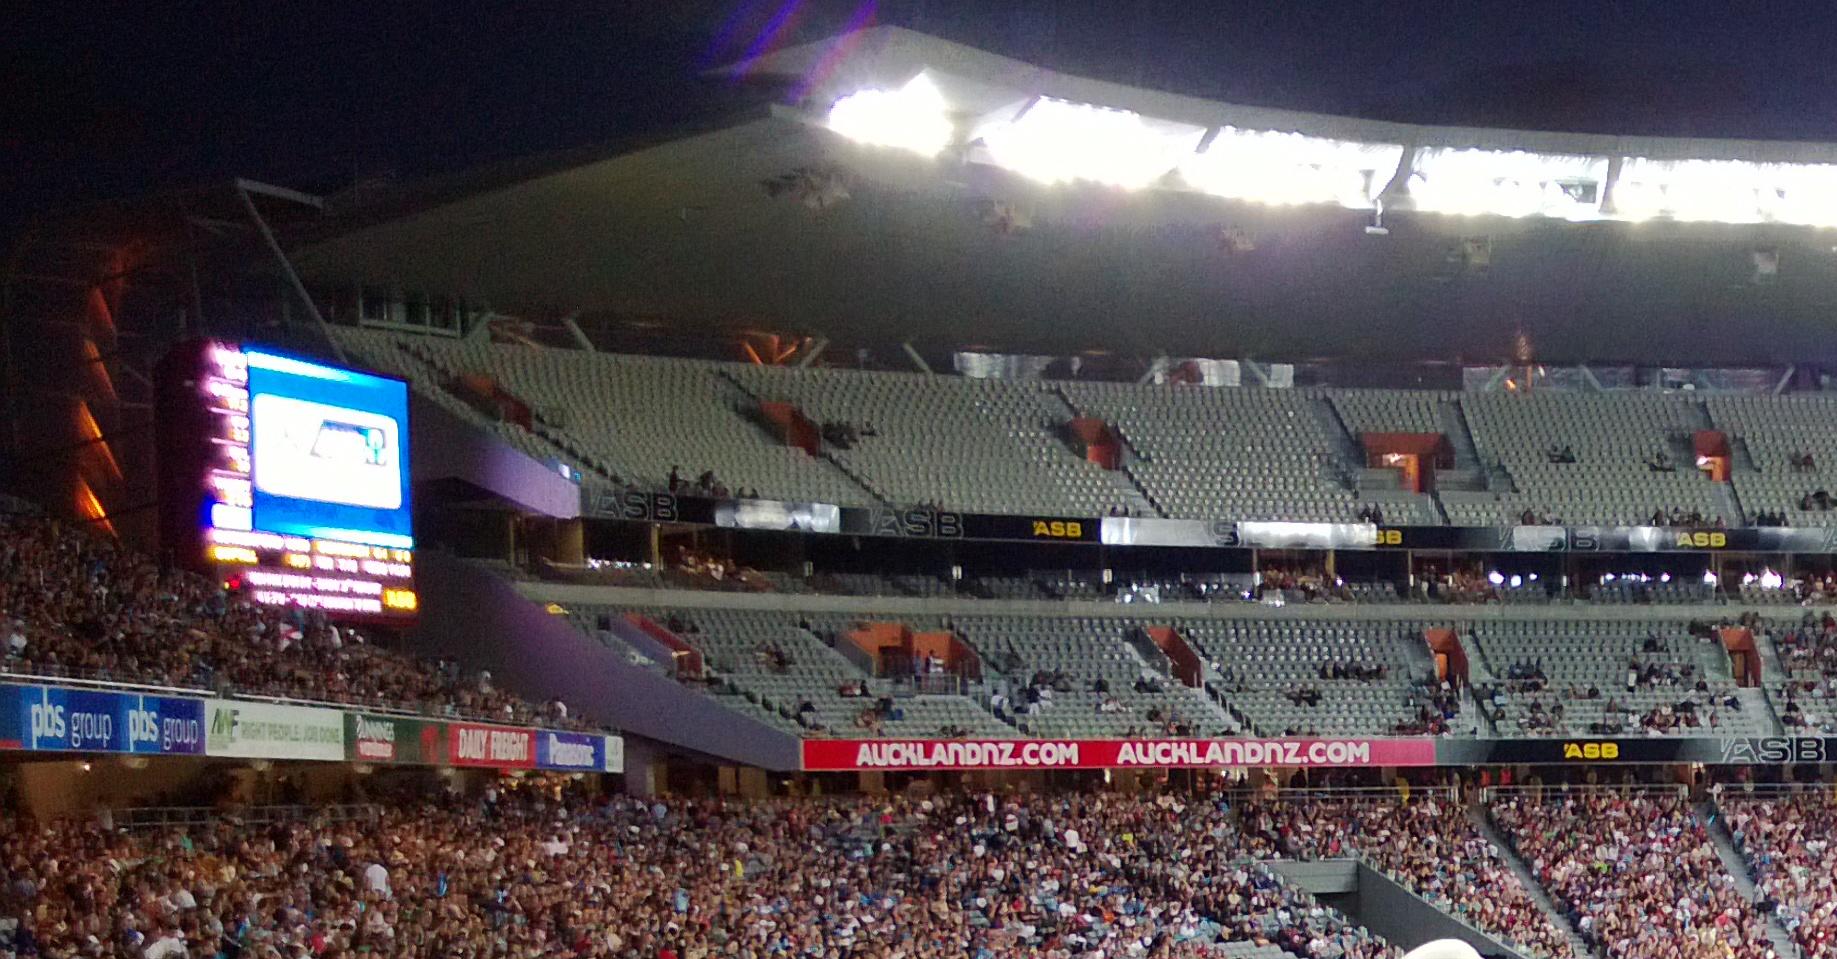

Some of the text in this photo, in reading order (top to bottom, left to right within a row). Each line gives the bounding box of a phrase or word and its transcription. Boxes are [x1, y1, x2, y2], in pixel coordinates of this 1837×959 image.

[1033, 520, 1082, 537] ASB
[1676, 532, 1725, 548] ASB
[32, 687, 113, 750] pbs group
[129, 695, 199, 752] pbs group
[459, 729, 529, 761] DAILY FREIGHT
[549, 732, 595, 767] Panasonic
[856, 742, 1079, 766] AUCKLANDNZ.COM
[1117, 741, 1370, 764] AUCKLANDNZ.COM
[1564, 743, 1619, 759] ASB
